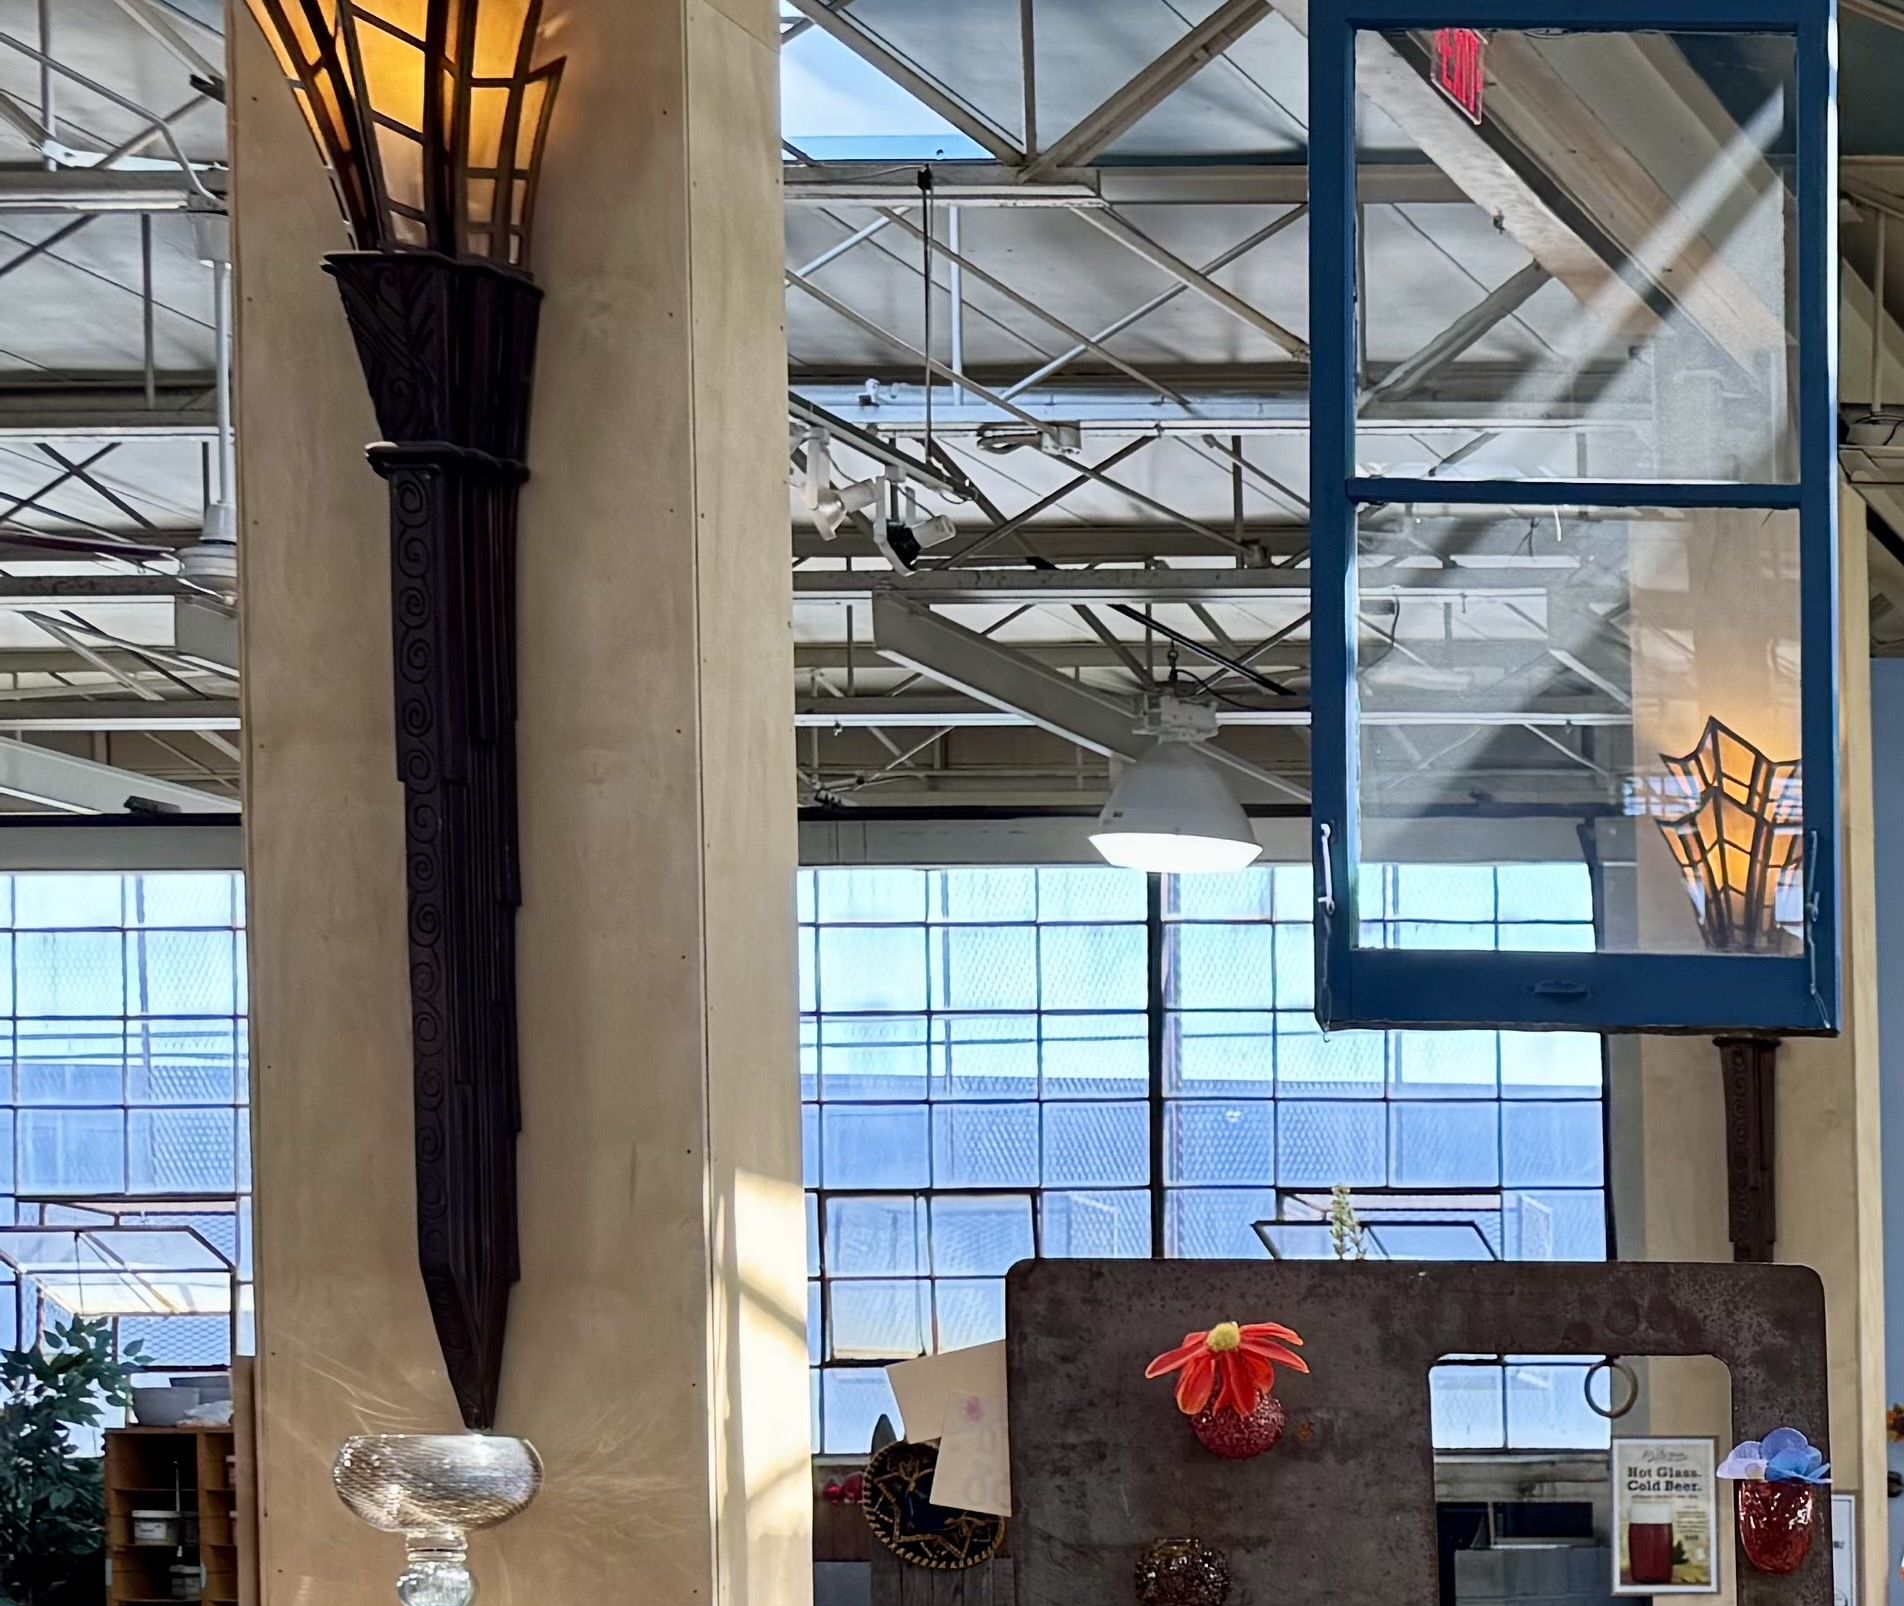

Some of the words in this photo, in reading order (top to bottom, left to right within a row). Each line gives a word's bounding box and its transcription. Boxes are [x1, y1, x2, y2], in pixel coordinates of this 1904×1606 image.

[1628, 1467, 1651, 1477] Hot
[1657, 1467, 1702, 1477] Glass.
[1628, 1481, 1660, 1491] Cold
[1665, 1481, 1702, 1491] Beer.
